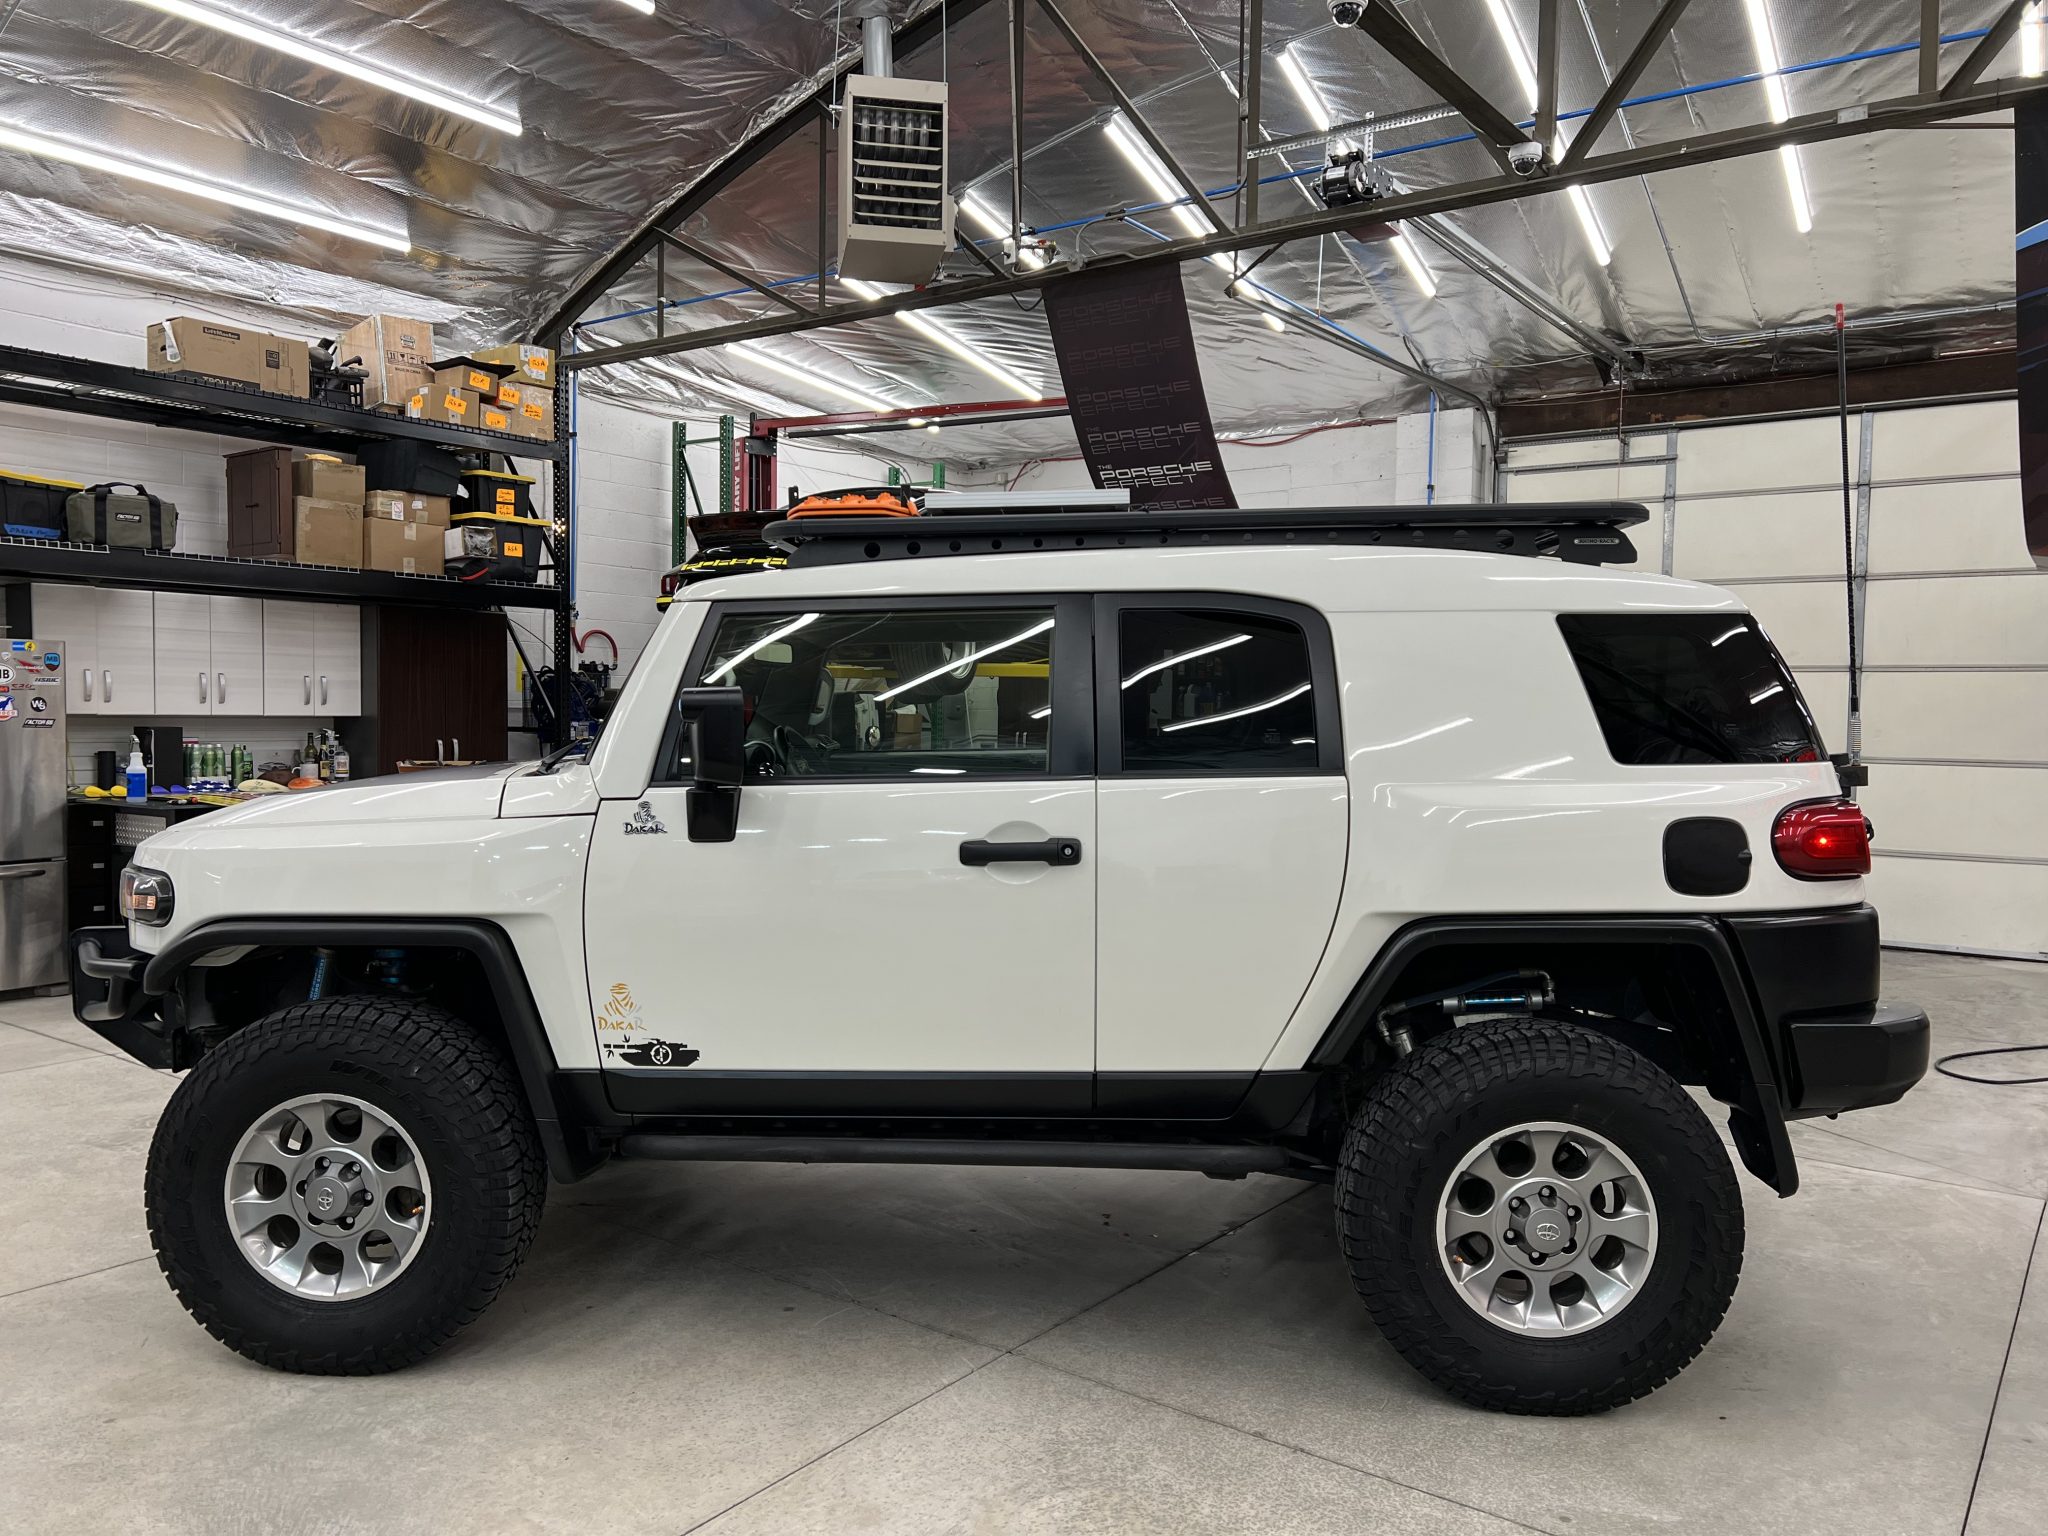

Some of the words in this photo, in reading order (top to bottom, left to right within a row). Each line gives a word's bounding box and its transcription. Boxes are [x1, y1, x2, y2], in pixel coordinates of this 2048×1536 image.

[1057, 290, 1173, 320] PORSCHE
[1060, 307, 1156, 334] EFFECT
[1067, 336, 1182, 363] PORSCHE
[1069, 352, 1165, 376] EFFECT
[1076, 380, 1191, 404] PORSCHE
[1079, 395, 1176, 417] EFFECT
[1087, 421, 1201, 444] PORSCHE
[1090, 435, 1185, 455] EFFECT
[1099, 460, 1214, 481] PORSCHE
[1103, 473, 1197, 489] EFFECT
[1130, 497, 1227, 511] ORSCHE
[0, 669, 10, 679] B
